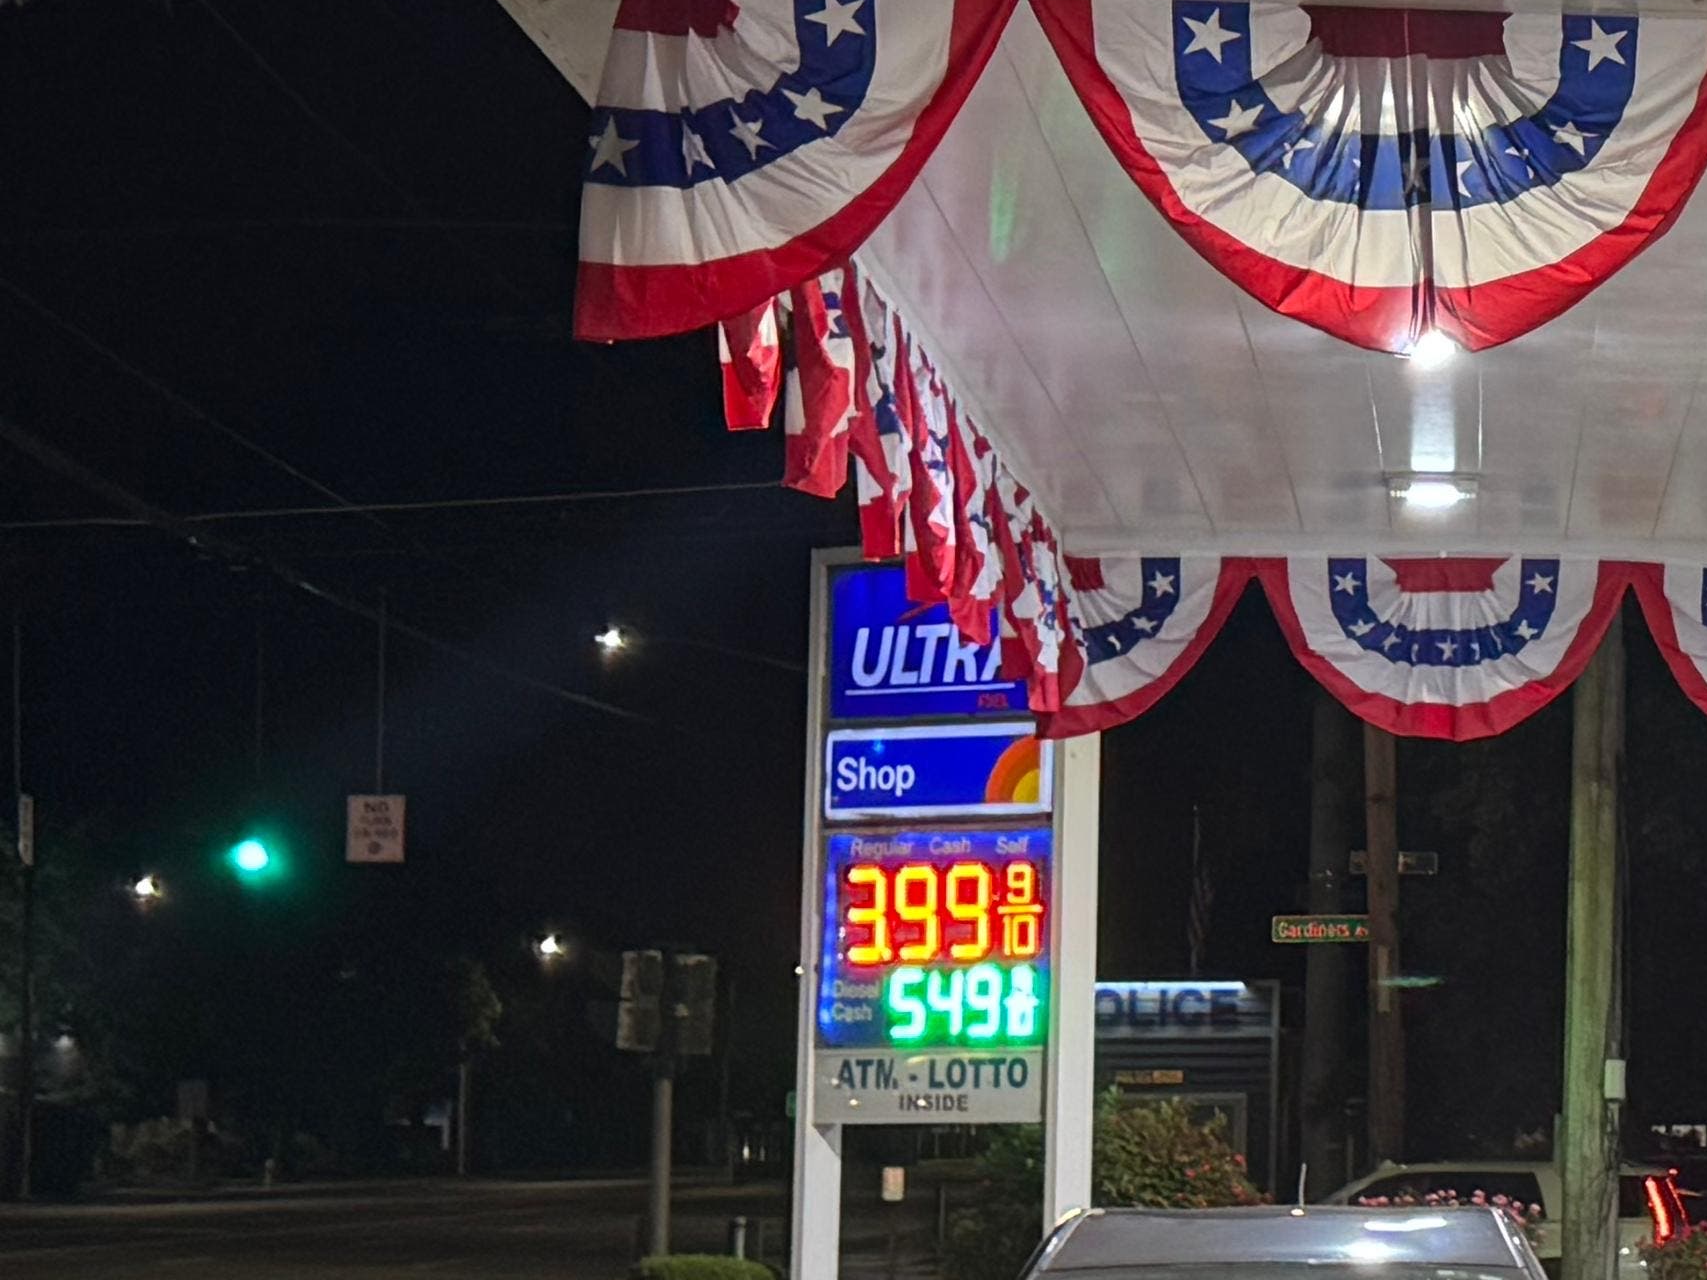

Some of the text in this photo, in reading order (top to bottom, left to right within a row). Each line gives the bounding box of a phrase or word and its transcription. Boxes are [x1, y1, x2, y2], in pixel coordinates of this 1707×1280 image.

[836, 755, 916, 796] Shop
[851, 836, 1028, 859] Regular Cash Self
[1095, 989, 1240, 1027] OLICE
[929, 1058, 1028, 1089] LOTTO
[900, 1094, 967, 1111] INSIDE
